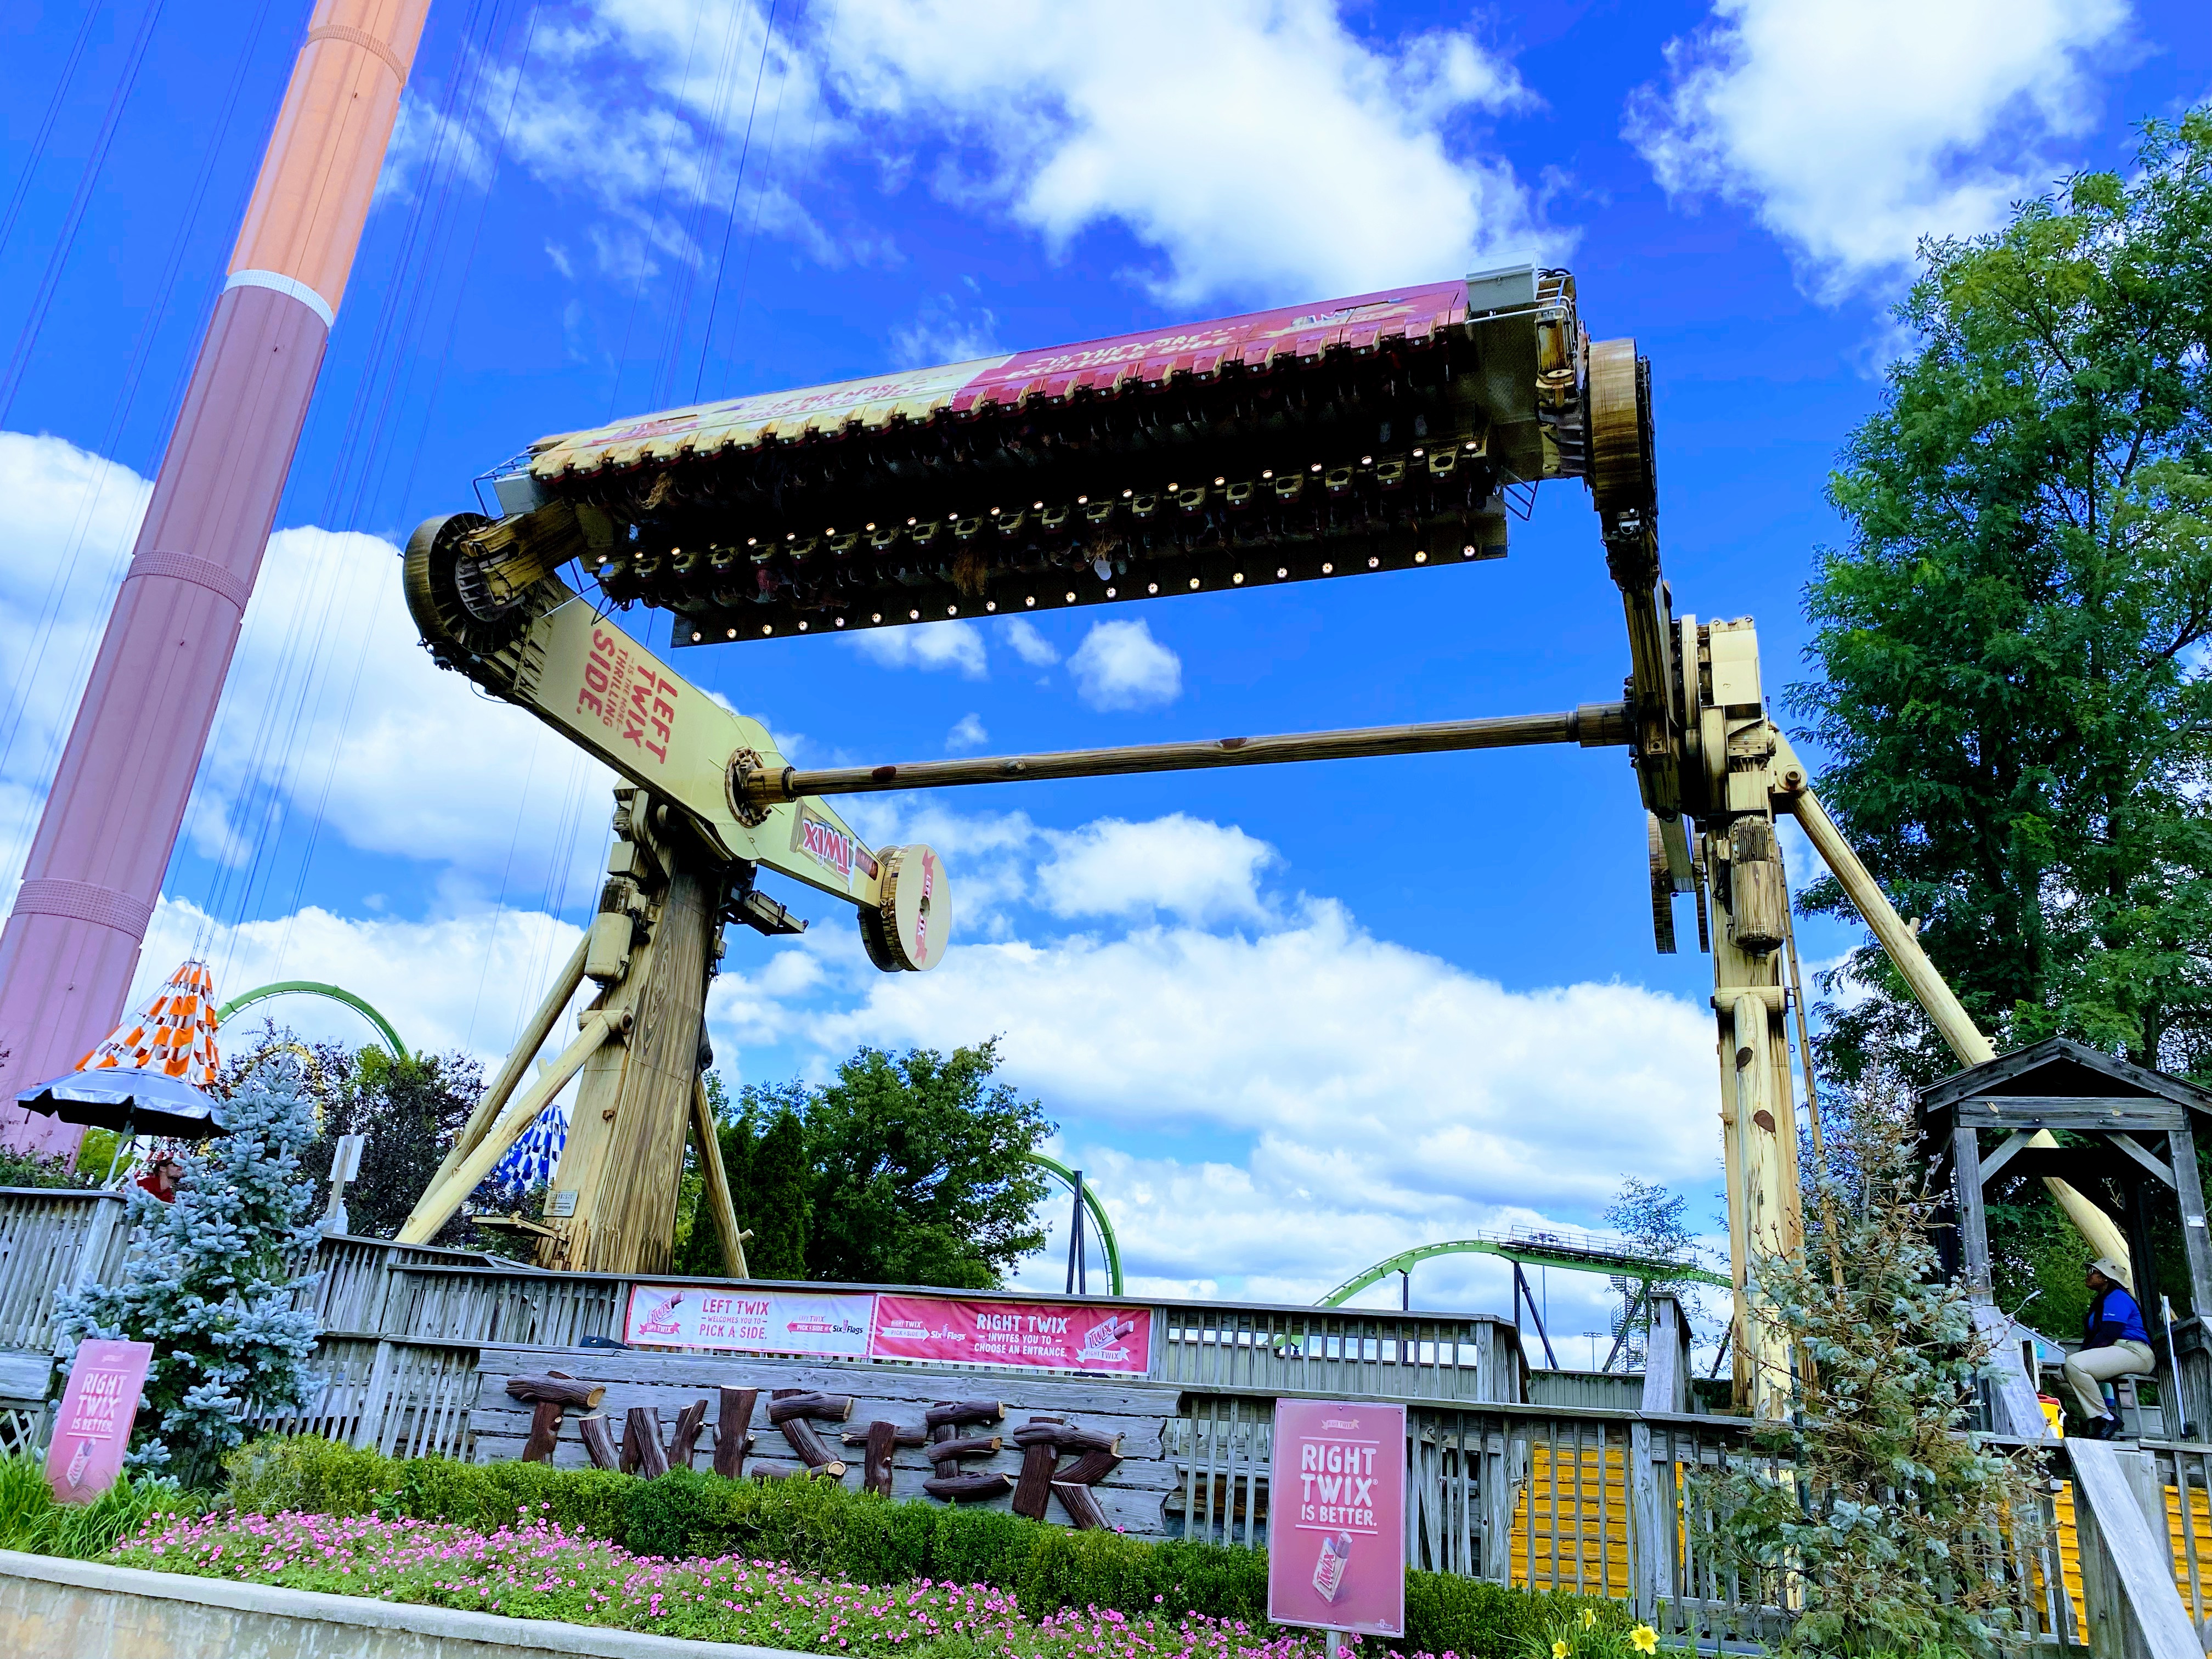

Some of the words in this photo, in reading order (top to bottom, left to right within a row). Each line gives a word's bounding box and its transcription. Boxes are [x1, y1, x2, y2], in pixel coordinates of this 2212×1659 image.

[1082, 346, 1125, 360] THE
[1131, 335, 1200, 353] MORE
[1005, 351, 1148, 379] EXCITING
[603, 648, 629, 727] THRILLING
[623, 678, 632, 696] THE
[617, 697, 628, 725] MORE
[623, 665, 657, 749] TWIX
[645, 678, 679, 764] LEFT
[702, 1299, 732, 1313] LEFT
[699, 1323, 725, 1337] PICK
[728, 1326, 735, 1338] A
[740, 1326, 767, 1339] SIDE.
[847, 1326, 863, 1335] Flags
[976, 1313, 1022, 1331] RIGHT
[930, 1330, 943, 1339] Six
[947, 1331, 967, 1341] Flags
[988, 1333, 1020, 1343] INVITES
[1022, 1334, 1039, 1344] YOU
[1041, 1335, 1052, 1345] TO
[974, 1342, 1006, 1353] CHOOSE
[1008, 1344, 1020, 1355] AN
[1022, 1345, 1068, 1357] ENTRANCE.
[82, 1373, 127, 1395] RIGHT
[71, 1418, 81, 1430] IS
[505, 1370, 1125, 1531] TWISTER
[1301, 1443, 1377, 1476] RIGHT
[1301, 1504, 1316, 1521] IS
[1319, 1505, 1378, 1527] BETTER.
